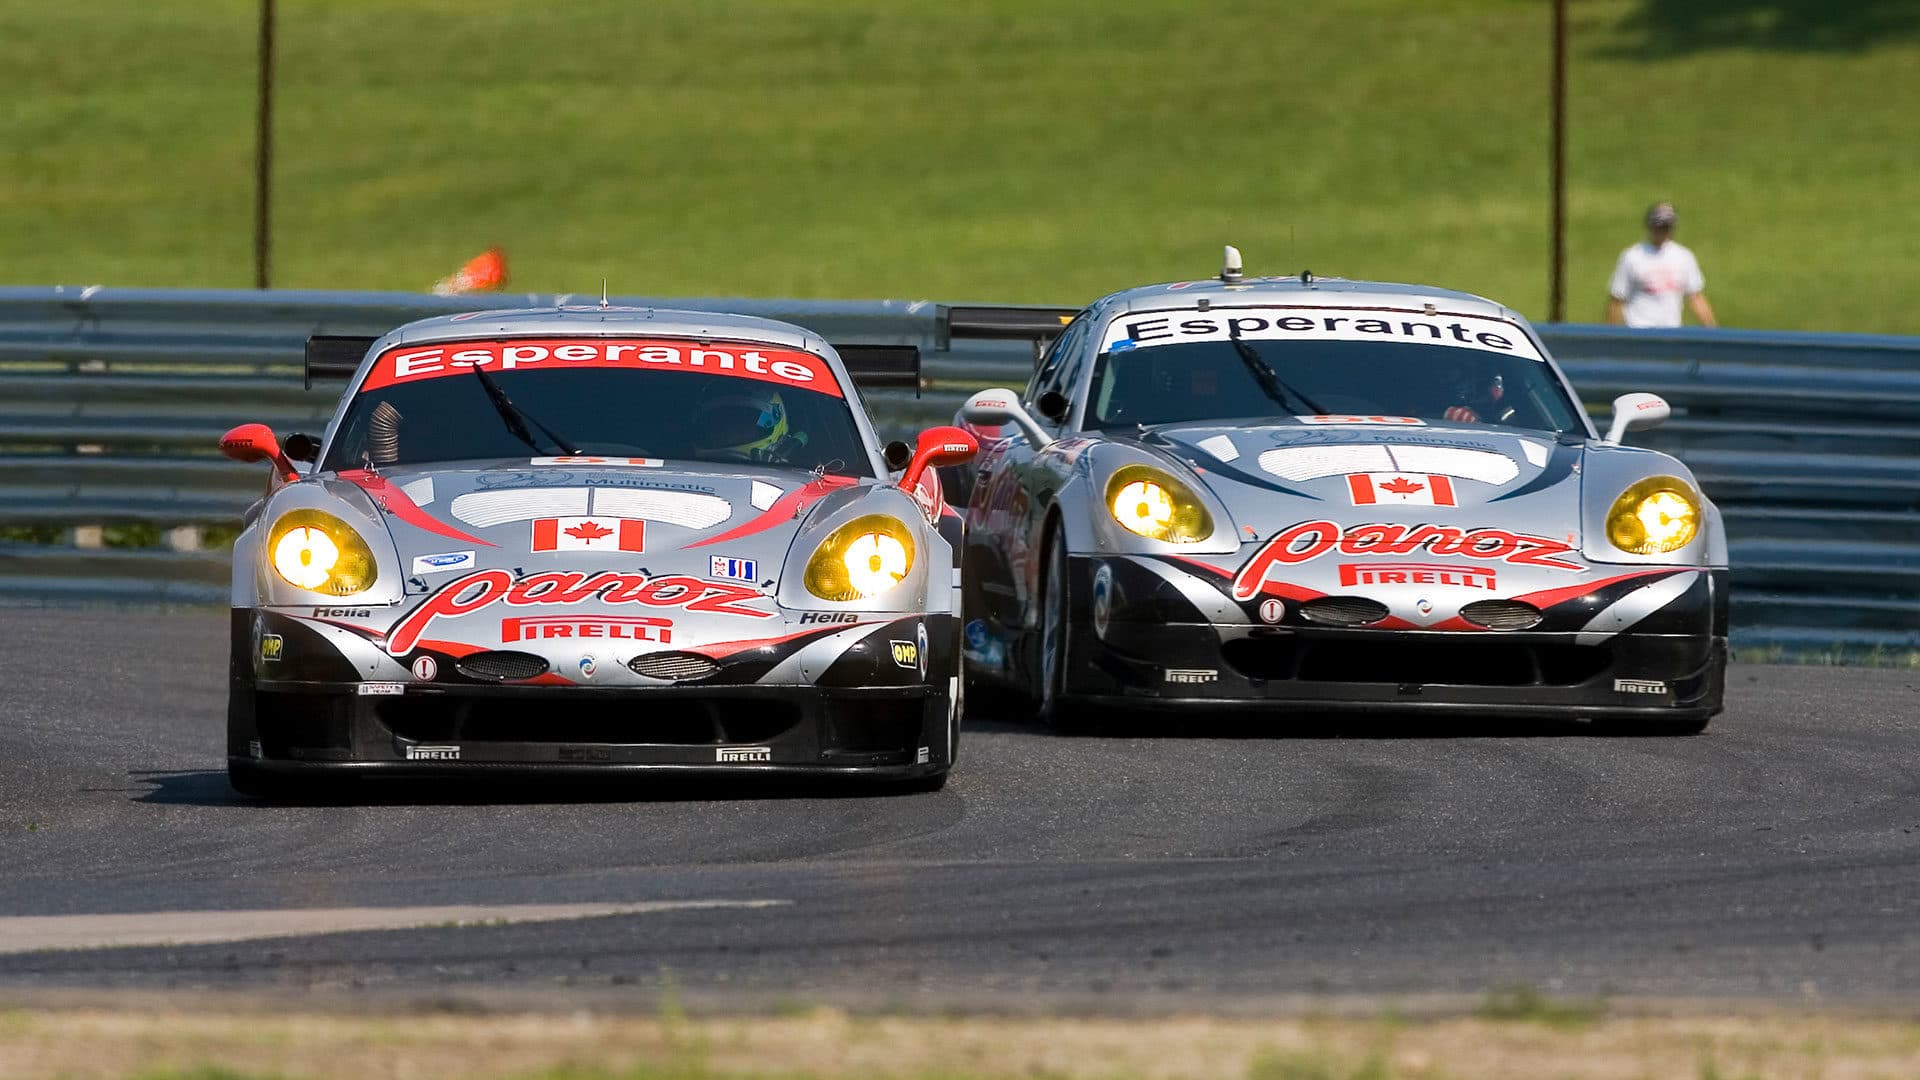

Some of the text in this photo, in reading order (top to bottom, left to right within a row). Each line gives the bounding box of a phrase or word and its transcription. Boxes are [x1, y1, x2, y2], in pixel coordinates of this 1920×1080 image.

[1127, 315, 1514, 350] Esperante
[394, 343, 815, 382] Esperante
[584, 478, 716, 492] Multimatic
[1338, 563, 1497, 591] PIRELLI
[312, 607, 371, 618] Hella
[799, 612, 858, 625] Hella
[502, 615, 673, 644] PIRELLI
[894, 645, 917, 664] OMP
[1165, 669, 1218, 683] PIRELLI
[1614, 679, 1667, 694] PIRELLI
[406, 745, 460, 760] PIRELLI
[716, 747, 771, 762] PIRELLI
